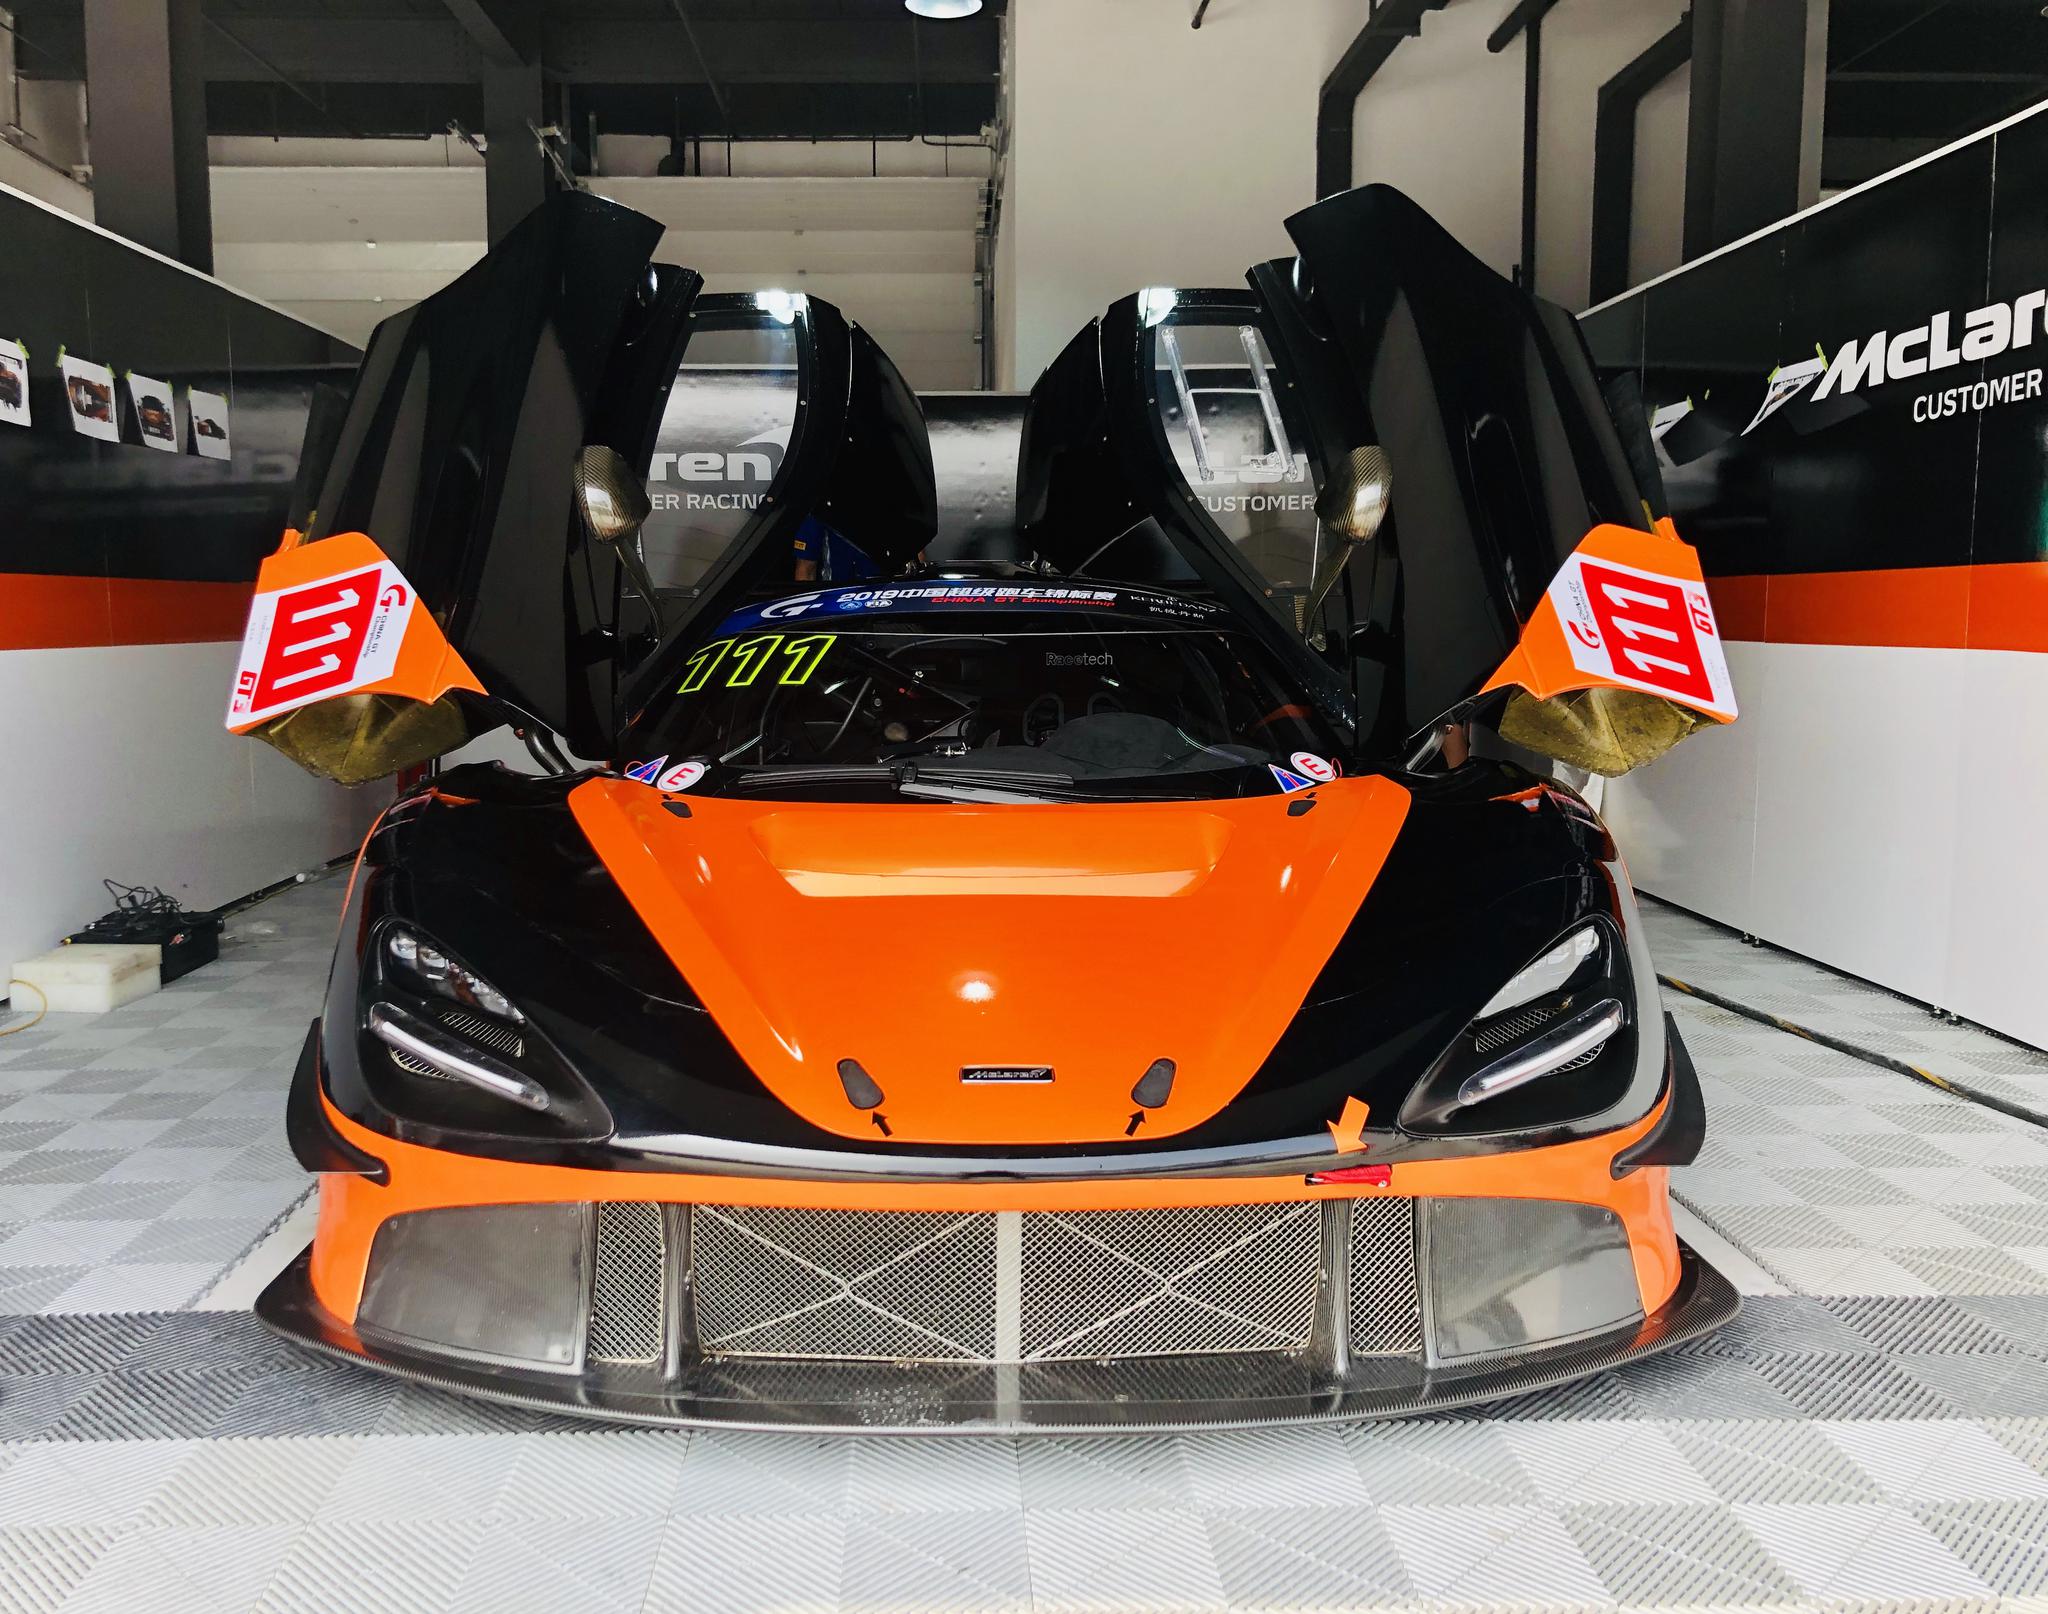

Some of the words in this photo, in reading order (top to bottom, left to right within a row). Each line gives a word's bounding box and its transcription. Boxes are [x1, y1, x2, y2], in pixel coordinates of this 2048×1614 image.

[1809, 288, 2048, 403] McLar
[1913, 368, 2043, 423] CUSTOMER
[272, 588, 360, 690] 111
[1601, 583, 1691, 676] 111
[677, 634, 838, 694] 111
[1045, 652, 1113, 666] Racetech
[666, 767, 696, 786] E
[1299, 757, 1328, 776] E
[968, 1069, 1042, 1079] McLaren
